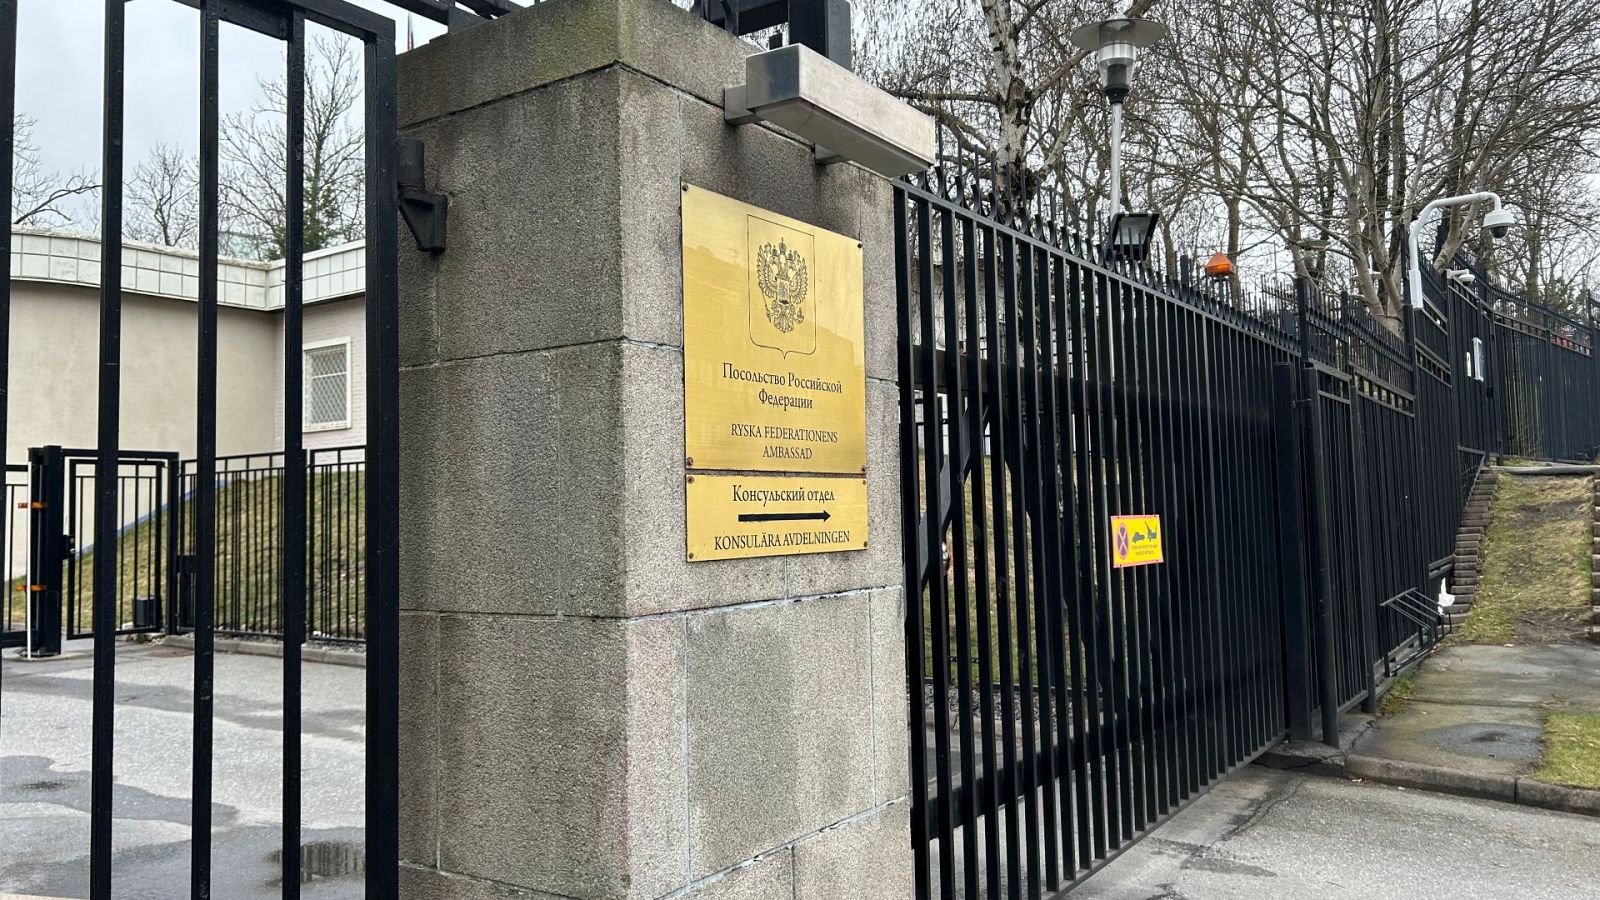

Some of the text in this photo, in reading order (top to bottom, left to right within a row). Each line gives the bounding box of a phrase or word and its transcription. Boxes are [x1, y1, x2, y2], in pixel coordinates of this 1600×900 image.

[722, 362, 842, 393] Посольство Российской
[758, 389, 813, 411] Федерации
[731, 423, 838, 443] RYSKA FEDERATIONENS
[763, 446, 813, 460] AMBASSAD
[732, 484, 835, 507] Консульский отдел
[714, 530, 850, 551] KONSULÄRA AVDELNINGEN
